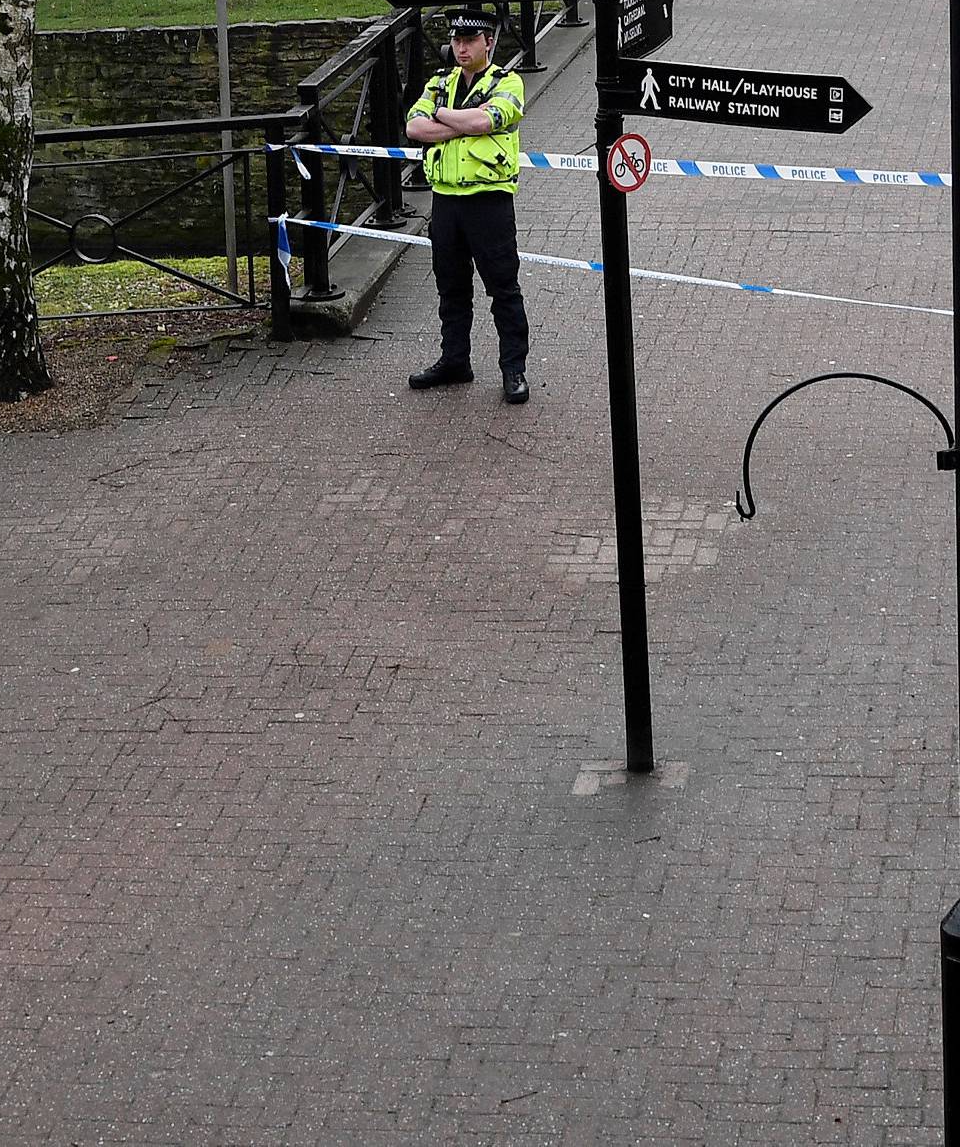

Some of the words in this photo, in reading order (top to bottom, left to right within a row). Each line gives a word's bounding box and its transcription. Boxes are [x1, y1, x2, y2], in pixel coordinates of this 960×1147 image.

[668, 75, 696, 89] CITY
[702, 78, 818, 100] HALL/PLAYHOUSE
[668, 96, 721, 112] RAILWAY
[728, 102, 780, 118] STATION
[560, 157, 592, 169] POLICE
[712, 165, 746, 176] POLICE
[791, 169, 826, 180] POLICE
[872, 173, 908, 183] POLICE
